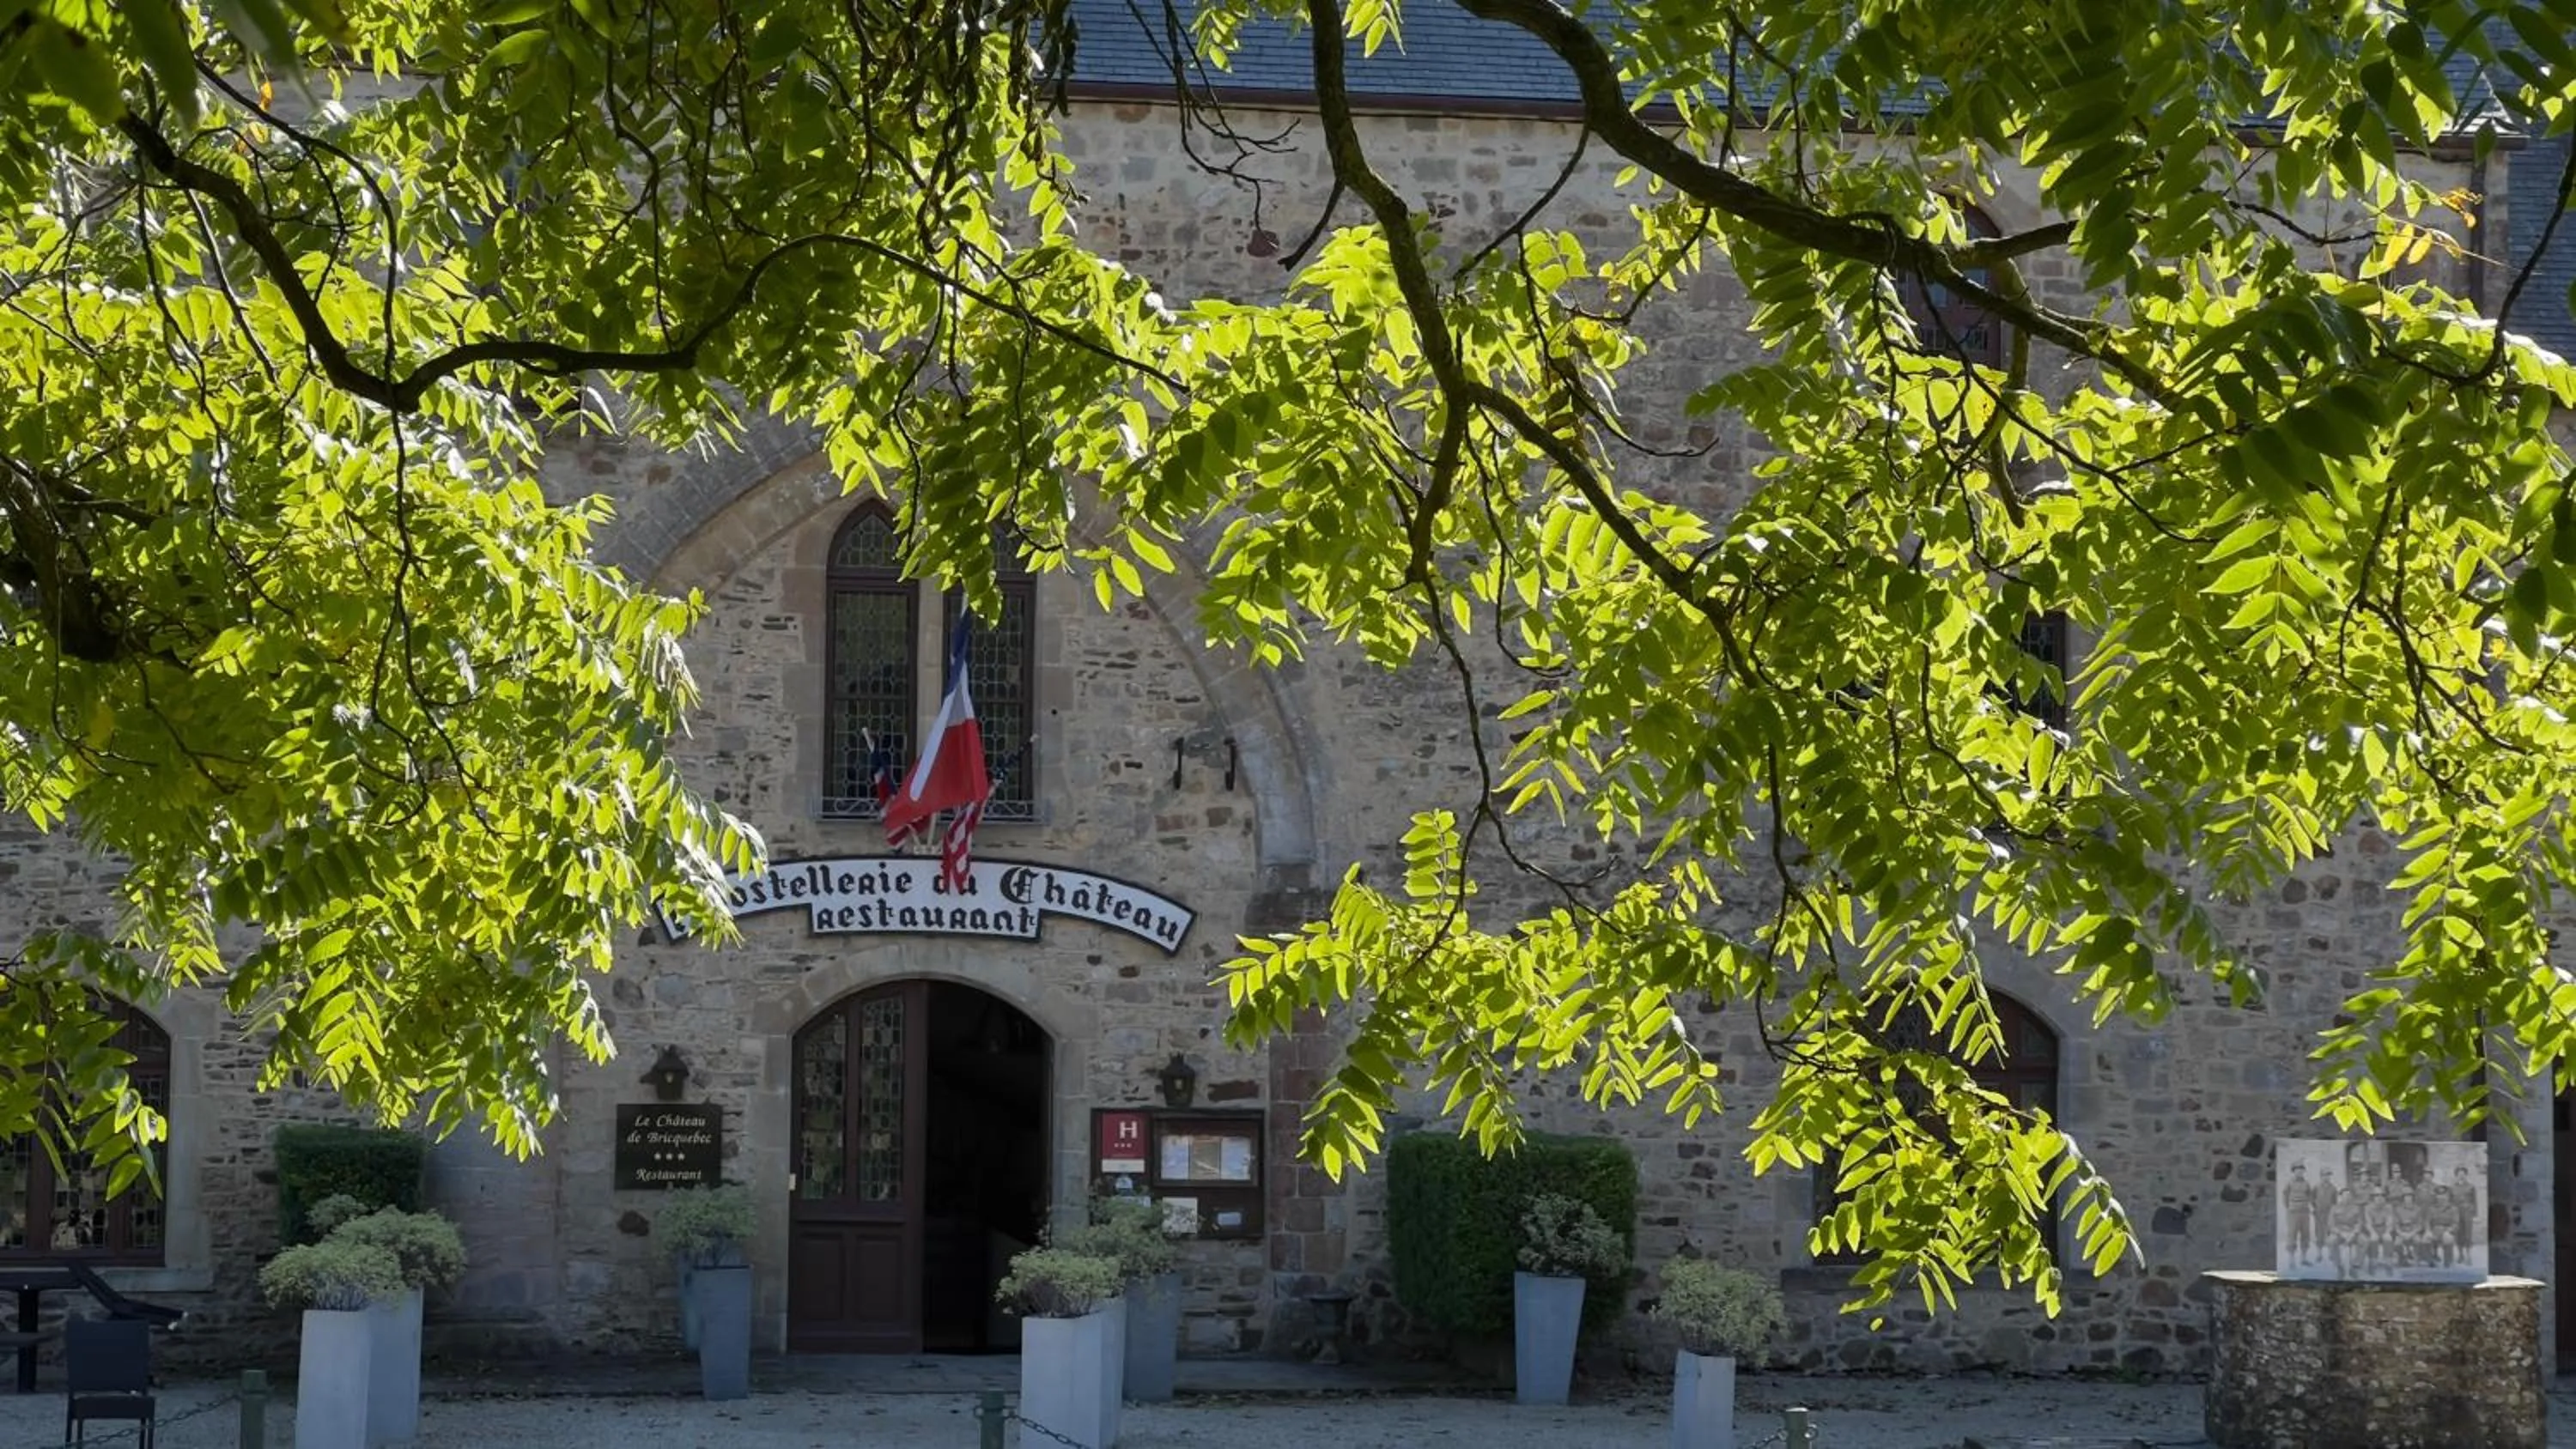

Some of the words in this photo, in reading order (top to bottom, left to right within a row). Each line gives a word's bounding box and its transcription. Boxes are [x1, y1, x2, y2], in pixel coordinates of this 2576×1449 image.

[1000, 866, 1178, 942] Château
[635, 1115, 650, 1126] Le
[657, 1113, 706, 1126] Château
[1120, 1121, 1138, 1138] H
[627, 1130, 641, 1143] de
[647, 1131, 712, 1147] Bricquebec
[635, 1168, 702, 1181] Restaurant
